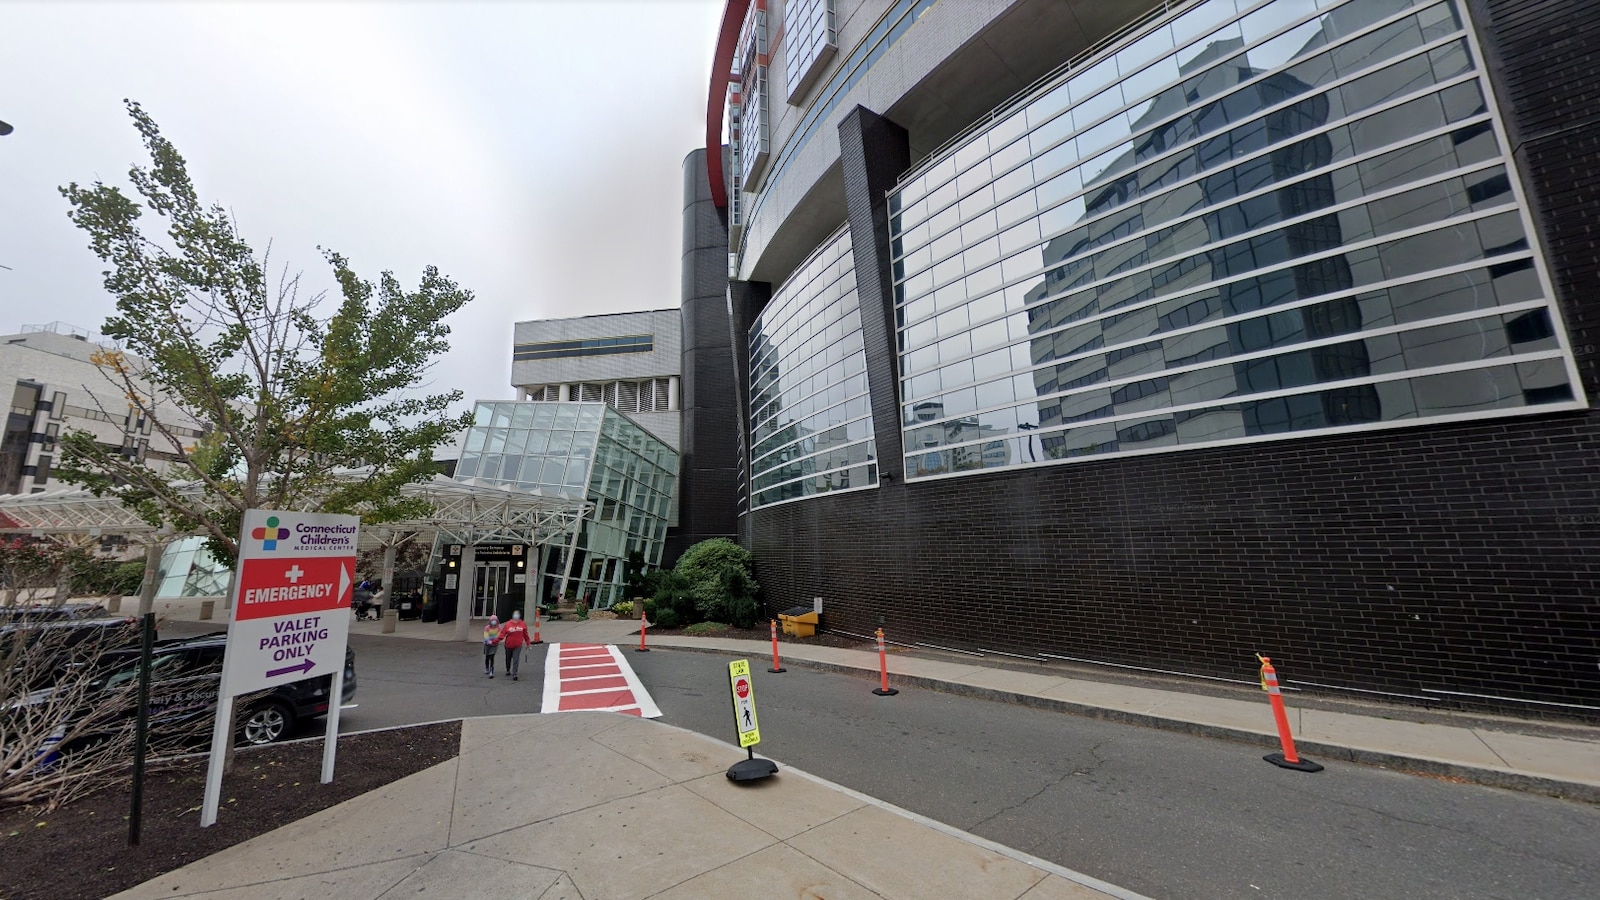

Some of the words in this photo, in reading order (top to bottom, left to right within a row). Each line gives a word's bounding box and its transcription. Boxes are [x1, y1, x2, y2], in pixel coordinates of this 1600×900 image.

[296, 523, 356, 534] Connecticut
[300, 534, 350, 545] Children's
[244, 583, 333, 604] EMERGENCY
[273, 616, 321, 634] VALET
[259, 628, 328, 650] PARKING
[273, 644, 315, 662] ONLY
[737, 684, 748, 692] STOP
